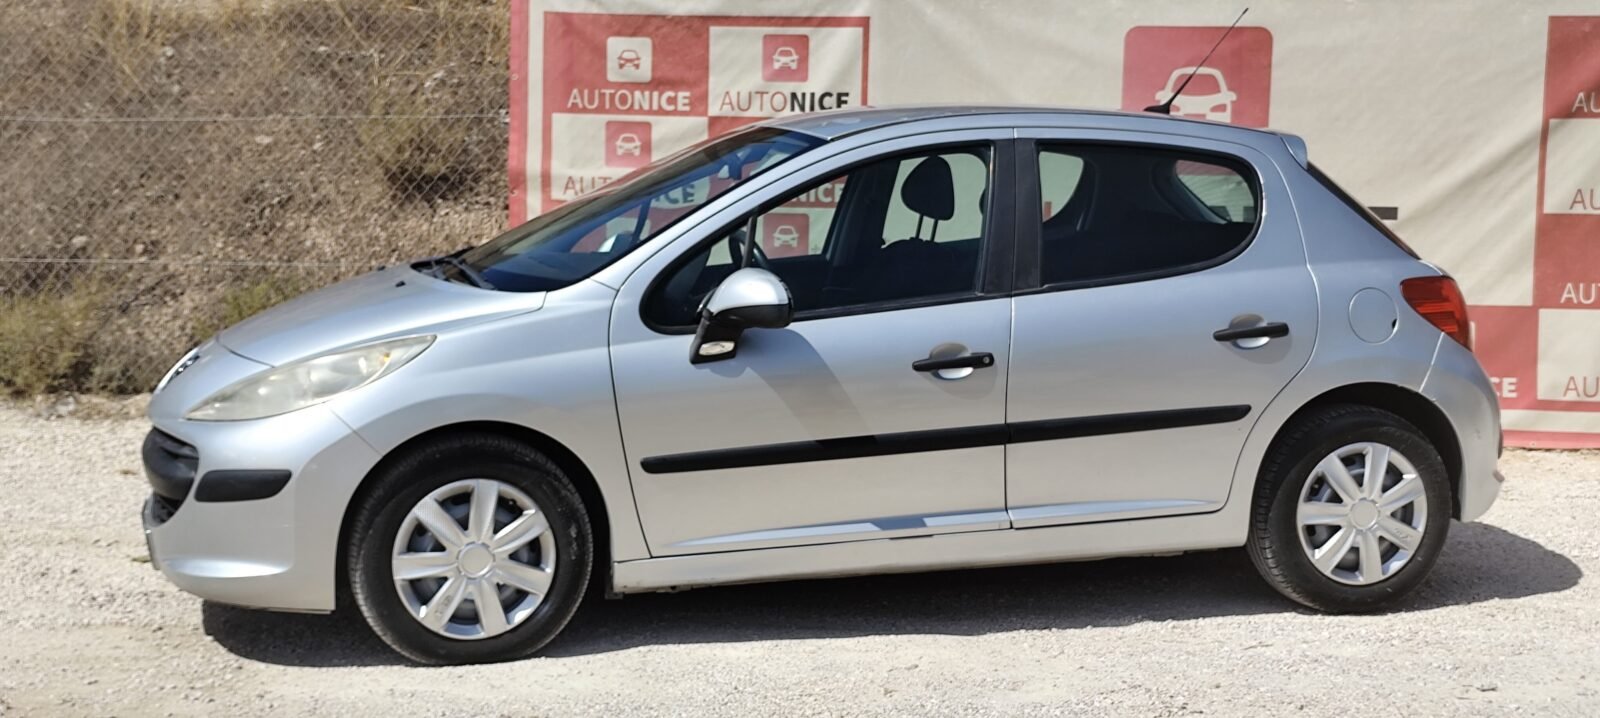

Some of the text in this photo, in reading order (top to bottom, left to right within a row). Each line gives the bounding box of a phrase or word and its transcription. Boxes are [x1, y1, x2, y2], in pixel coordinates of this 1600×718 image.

[567, 88, 691, 111] AUTONICE
[719, 91, 849, 112] AUTONICE
[1560, 282, 1600, 304] AU
